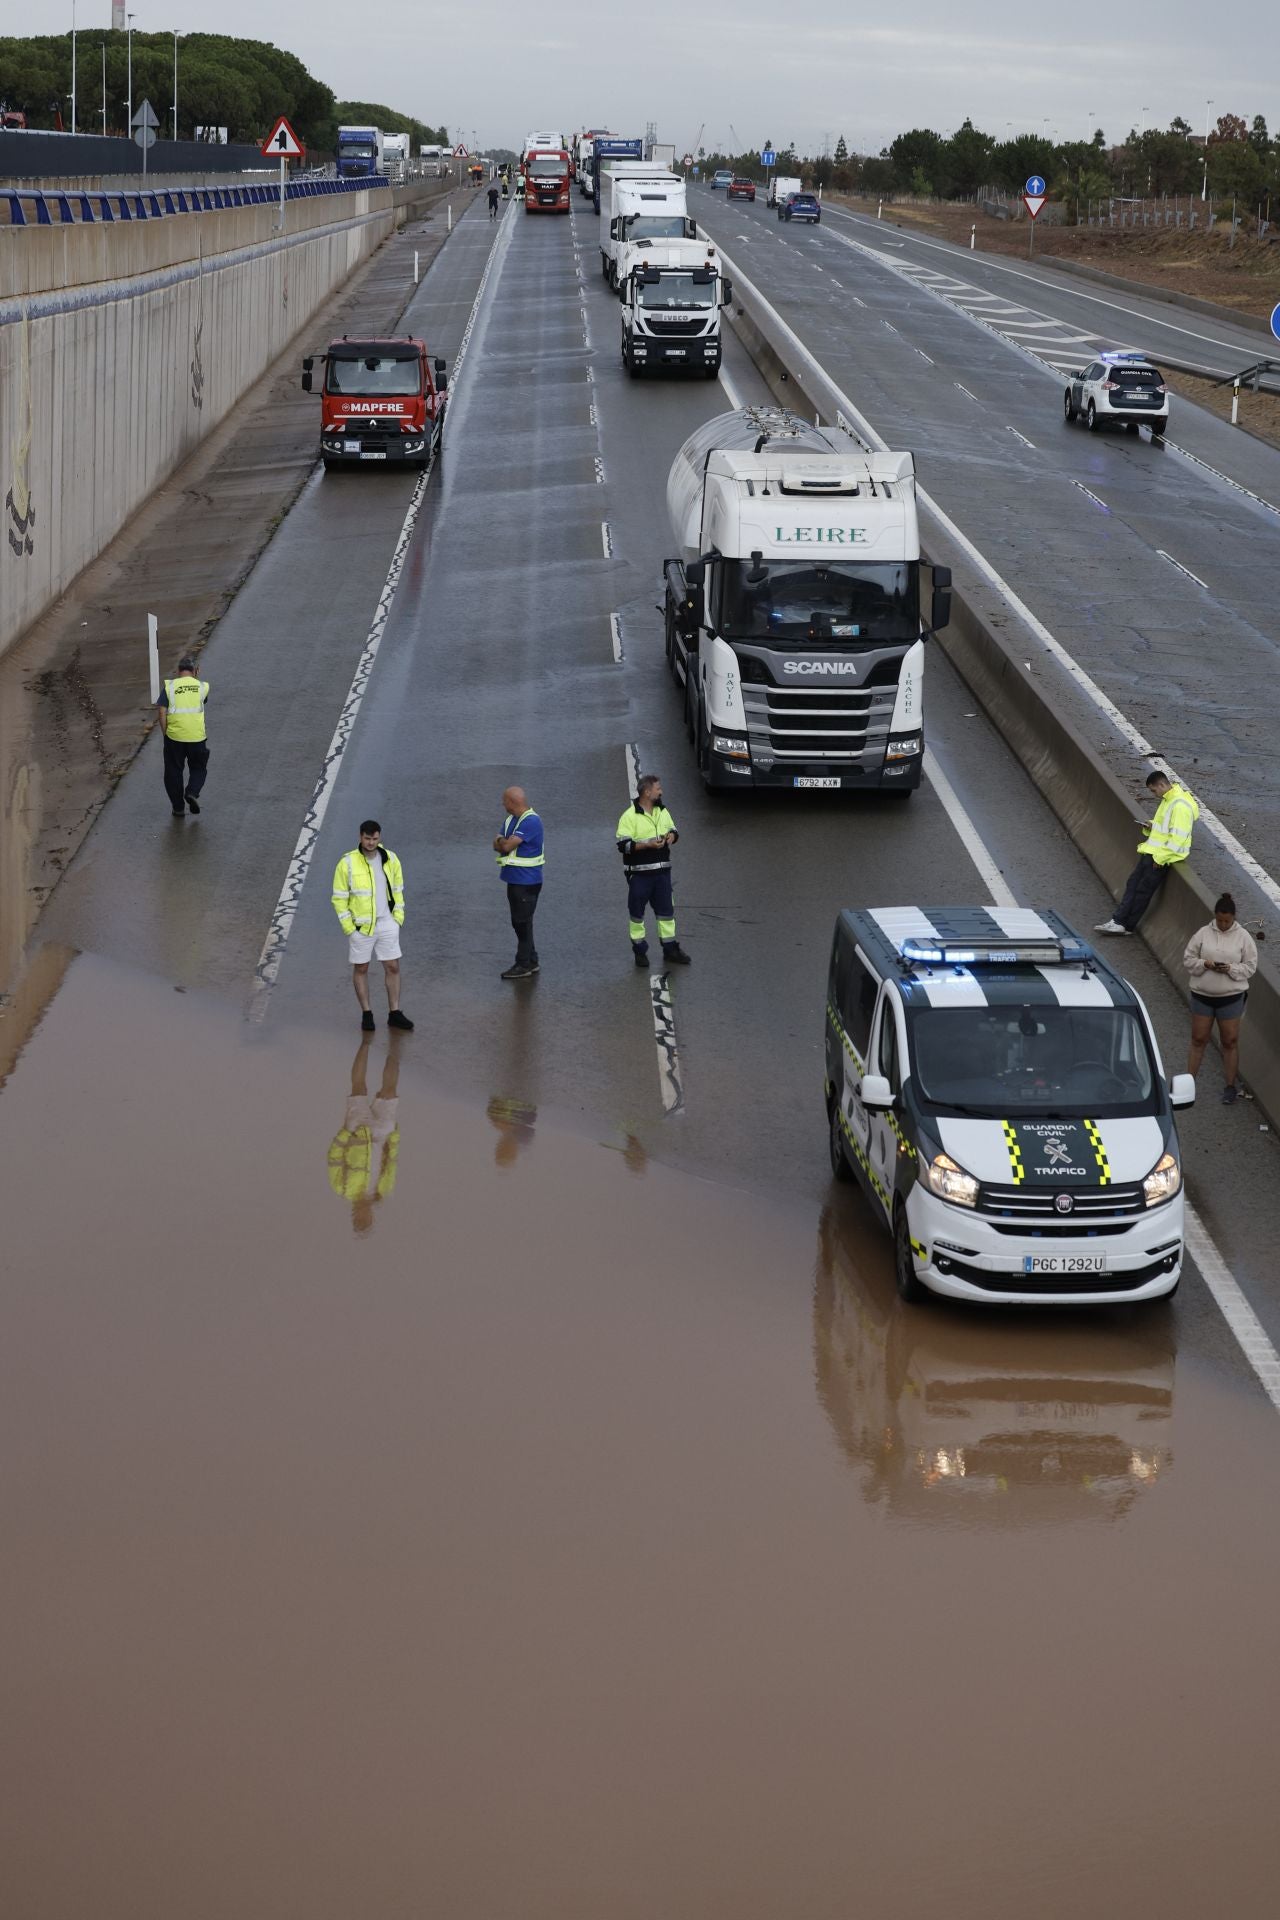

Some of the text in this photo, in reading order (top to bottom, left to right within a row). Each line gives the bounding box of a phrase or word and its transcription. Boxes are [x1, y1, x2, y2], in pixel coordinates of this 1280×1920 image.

[350, 403, 404, 412] MAPFRE
[775, 527, 869, 544] LEIRE
[783, 661, 857, 675] SCANIA
[726, 672, 734, 707] DAVID
[904, 672, 913, 714] IRACHE
[799, 778, 838, 787] 6792 KXW
[1034, 1167, 1087, 1176] TRAFICO
[1032, 1258, 1059, 1271] PGC
